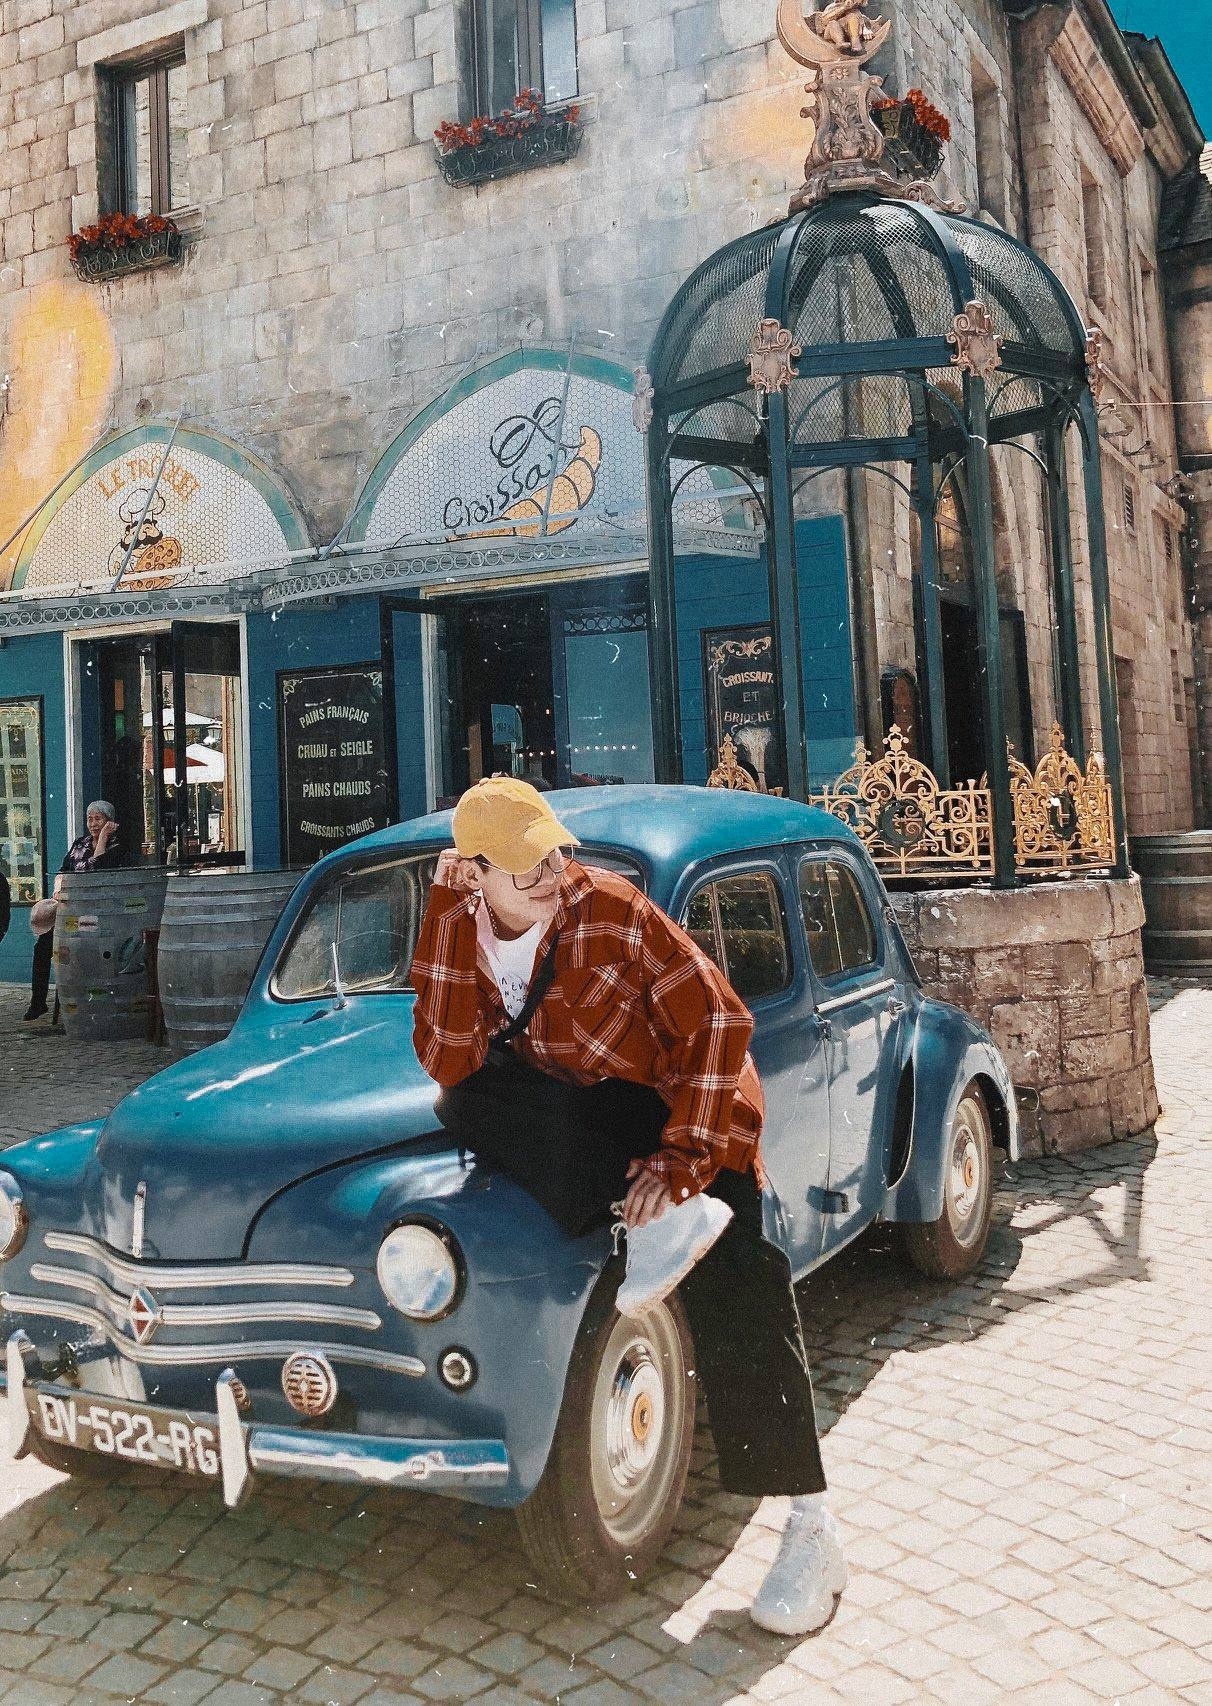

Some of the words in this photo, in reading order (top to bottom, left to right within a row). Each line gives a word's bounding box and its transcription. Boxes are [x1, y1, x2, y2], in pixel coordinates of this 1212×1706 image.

[98, 467, 127, 500] LE
[742, 690, 760, 702] ET
[299, 708, 326, 729] PAINS
[326, 705, 370, 724] FRANÇAIS
[340, 740, 374, 757] SEIGLE
[302, 782, 331, 798] PAINS
[333, 780, 371, 797] CHAUDS
[300, 820, 345, 838] CROISSANTS
[345, 817, 375, 836] CHAUDS
